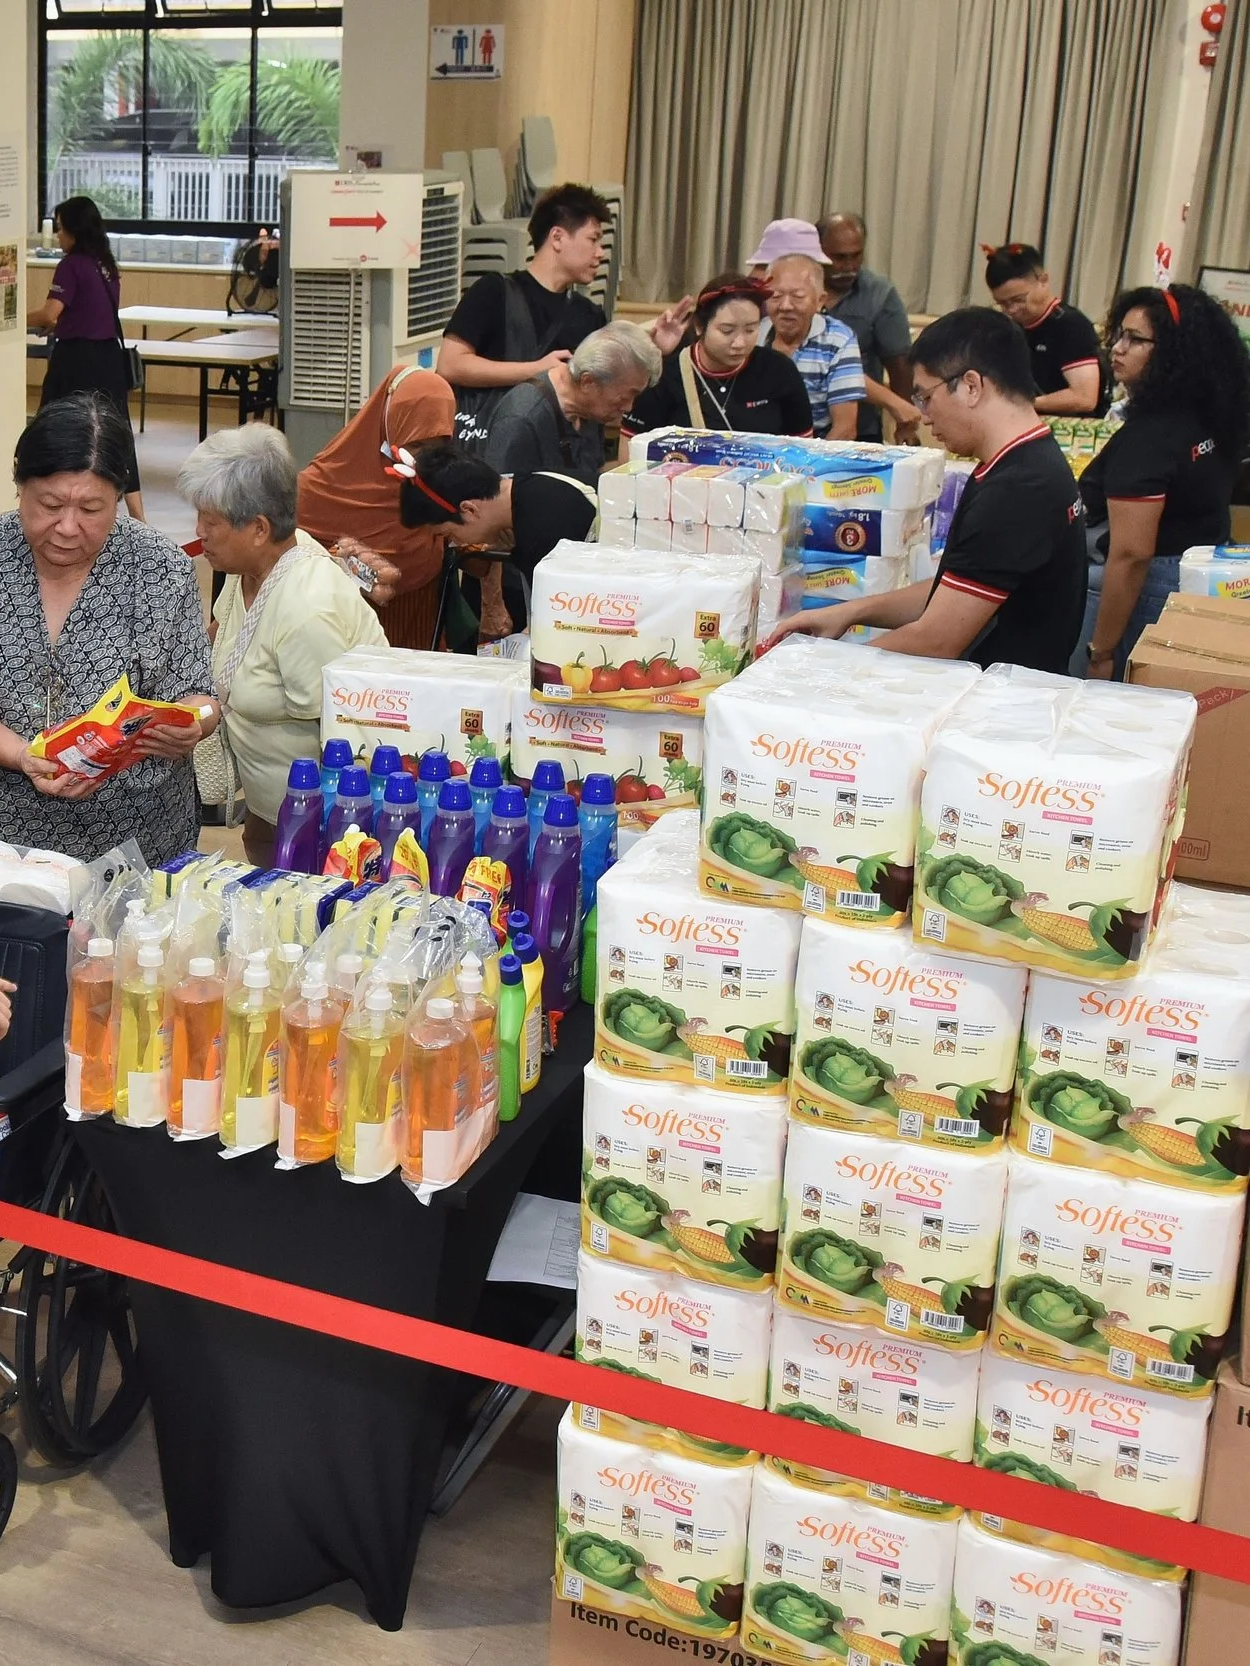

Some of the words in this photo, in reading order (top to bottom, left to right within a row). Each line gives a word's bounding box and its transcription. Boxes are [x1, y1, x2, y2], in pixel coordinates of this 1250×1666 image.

[852, 484, 877, 497] MORE
[1225, 576, 1250, 591] MOR
[551, 591, 636, 618] Softess
[607, 593, 640, 601] PREMIUM
[700, 614, 717, 622] Extra
[699, 622, 715, 633] 60
[333, 687, 408, 712] Softess
[526, 709, 605, 734] Softess
[576, 710, 606, 718] PREMIUM
[464, 719, 479, 728] 60
[664, 742, 678, 751] 60
[752, 733, 859, 771] Softess
[820, 739, 862, 750] PREMIUM
[1057, 778, 1102, 791] PREMIUM
[978, 772, 1098, 813] Softess
[1047, 813, 1069, 821] KITCHEN
[1181, 841, 1206, 857] 00ml
[639, 911, 741, 945] Softess
[705, 915, 744, 926] PREMIUM
[850, 959, 960, 999] Softess
[921, 967, 963, 979] PREMIUM
[1081, 990, 1202, 1031] Softess
[1160, 997, 1205, 1011] PREMIUM
[624, 1104, 724, 1143] Softess
[687, 1112, 726, 1124] PREMIUM
[838, 1155, 946, 1198] Softess
[907, 1164, 949, 1178] PREMIUM
[1057, 1198, 1176, 1242] Softess
[1134, 1209, 1180, 1223] PREMIUM
[616, 1289, 710, 1328] Softess
[677, 1296, 712, 1310] PREMIUM
[815, 1334, 920, 1375] Softess
[882, 1343, 922, 1358] PREMIUM
[1028, 1379, 1144, 1426] Softess
[1103, 1391, 1147, 1407] PREMIUM
[600, 1467, 695, 1506] Softess
[661, 1474, 697, 1489] PREMIUM
[799, 1516, 903, 1558] Softess
[867, 1526, 906, 1541] PREMIUM
[1012, 1572, 1127, 1615] Softess
[1085, 1582, 1128, 1597] PREMIUM
[570, 1601, 619, 1632] Item
